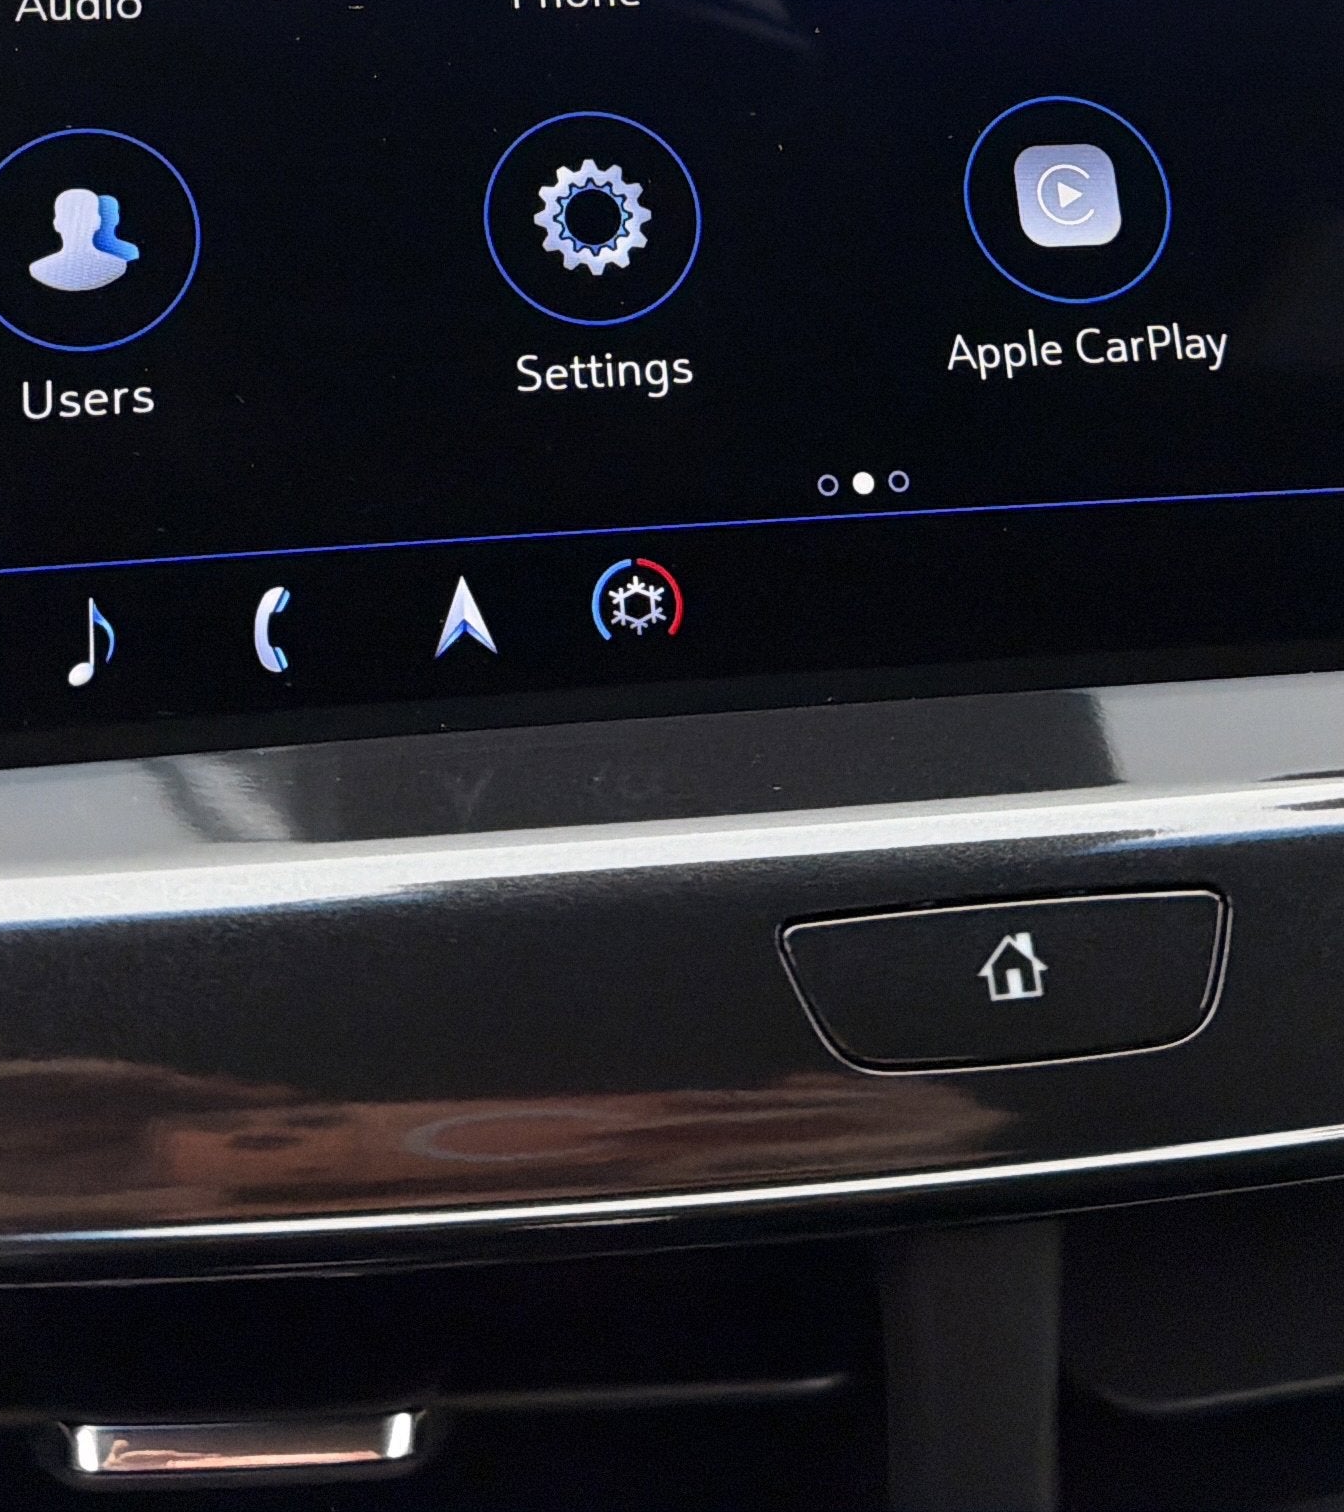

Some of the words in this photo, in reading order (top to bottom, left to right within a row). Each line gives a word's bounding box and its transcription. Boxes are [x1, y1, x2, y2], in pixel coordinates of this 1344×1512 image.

[947, 329, 1063, 380] Apple
[1075, 321, 1229, 371] CarPlay
[515, 351, 694, 398] Settings
[21, 379, 156, 420] Users
